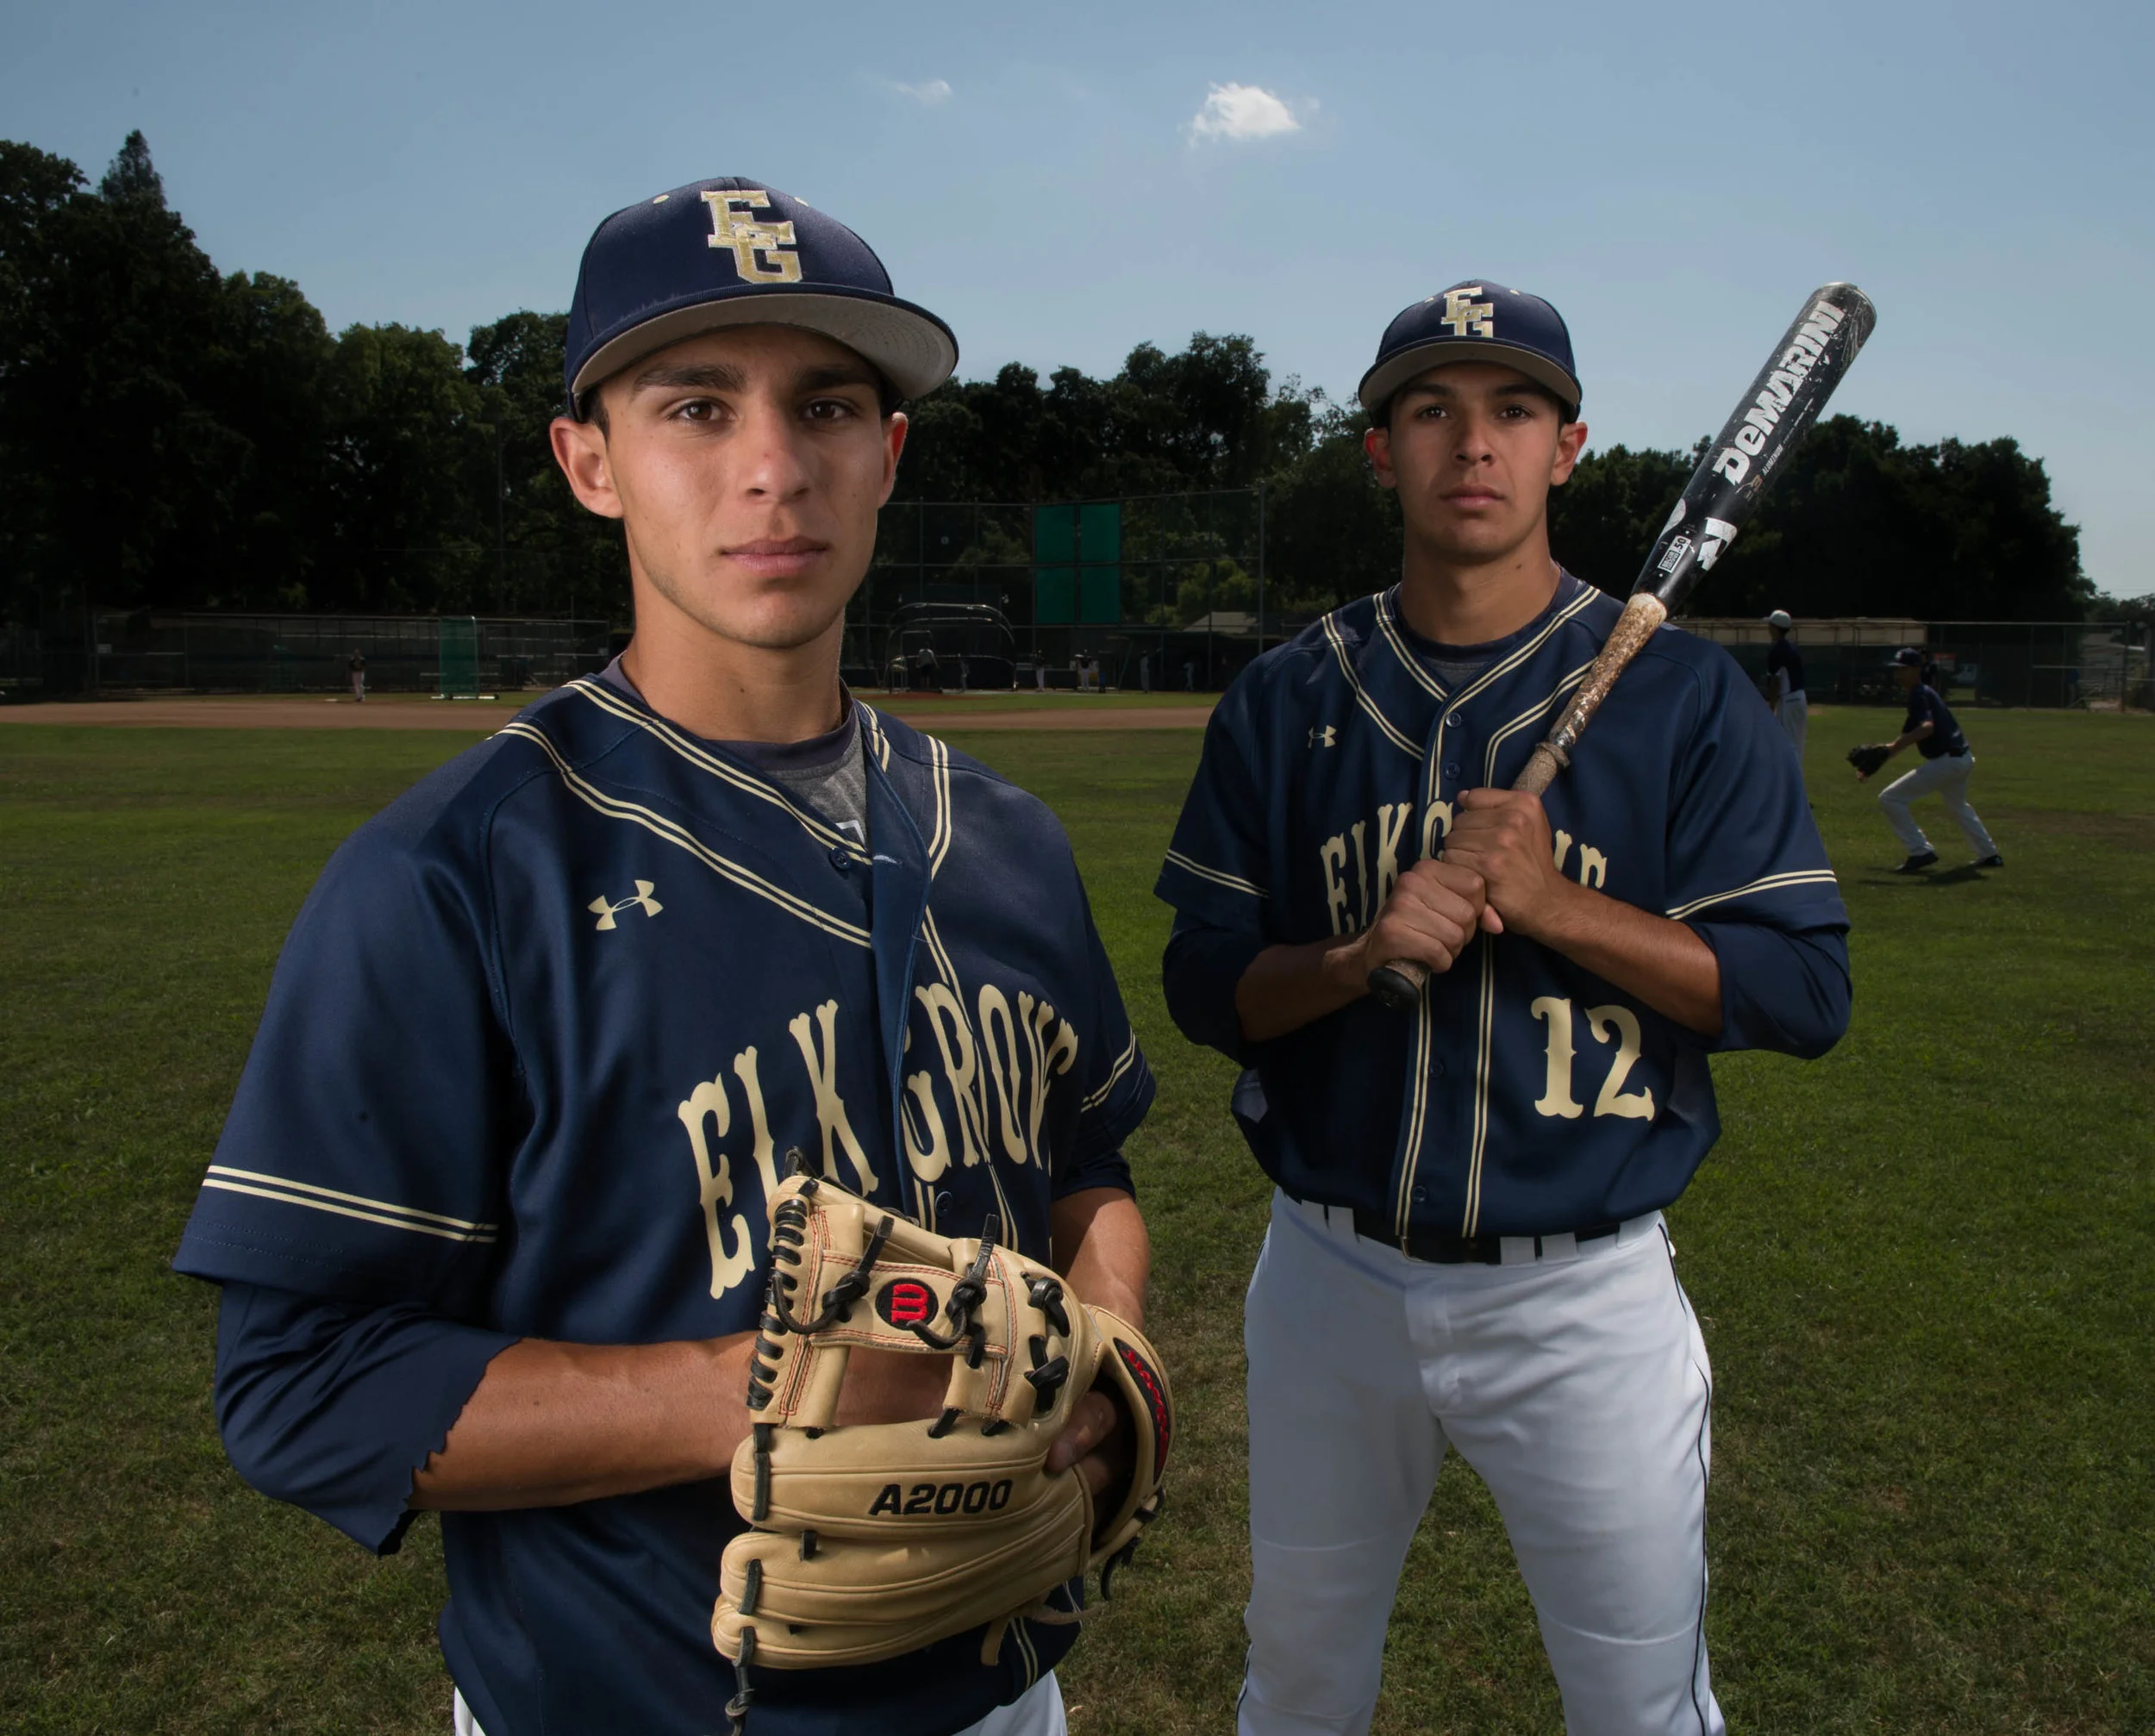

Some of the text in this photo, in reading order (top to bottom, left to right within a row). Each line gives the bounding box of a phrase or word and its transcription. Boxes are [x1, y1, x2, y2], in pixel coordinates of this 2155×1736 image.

[1530, 996, 1655, 1121] 12
[678, 998, 878, 1300] ELK
[868, 1479, 1013, 1516] A2000
